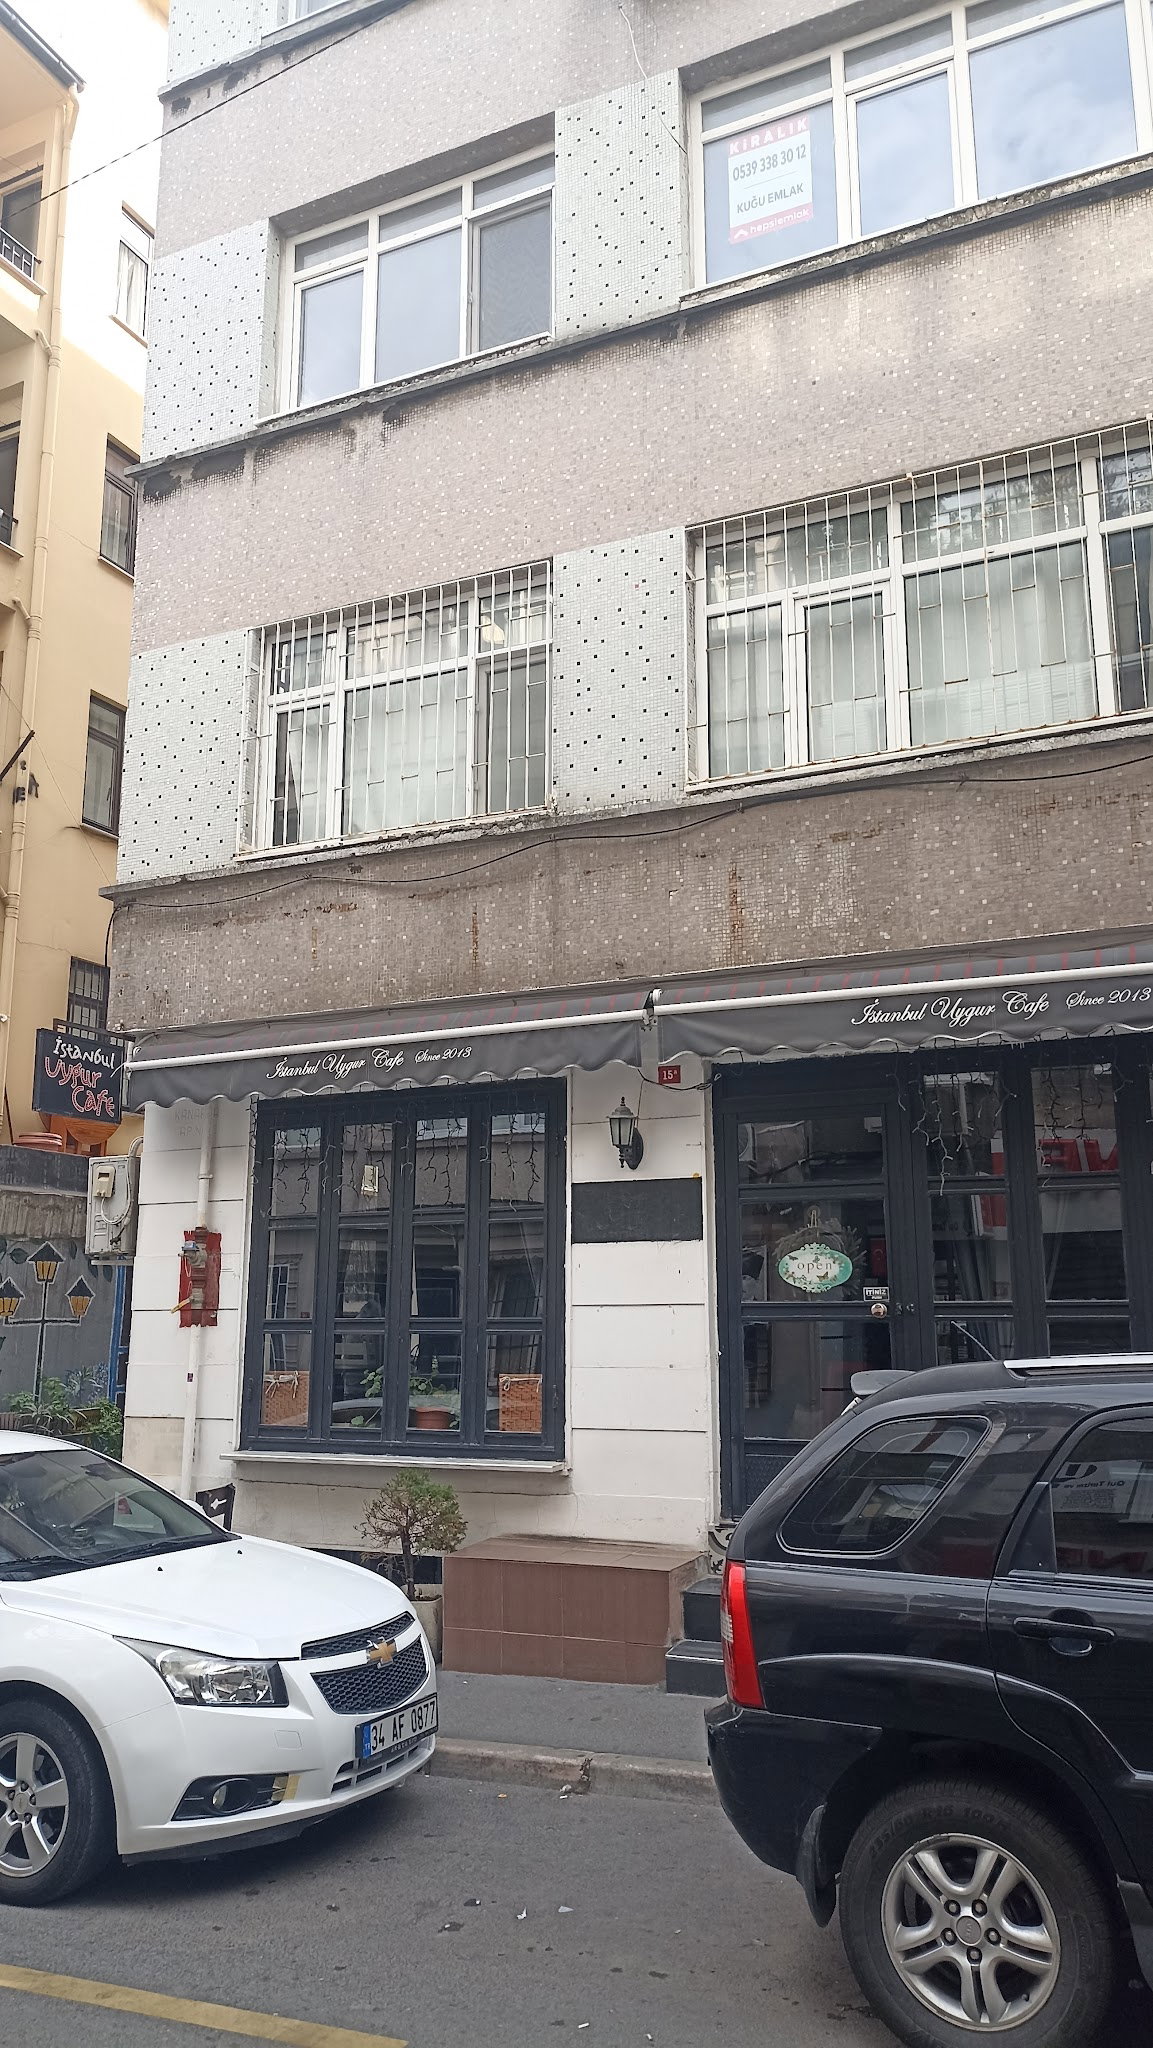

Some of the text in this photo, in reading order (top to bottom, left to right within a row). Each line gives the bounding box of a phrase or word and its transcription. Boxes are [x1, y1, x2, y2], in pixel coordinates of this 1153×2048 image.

[732, 144, 807, 181] 0539 338 30 12
[737, 182, 804, 214] KUĞU EMLAK
[750, 208, 810, 234] hepsiemlak
[851, 987, 1151, 1028] İstanbul Uygur Cafe Since 2013
[44, 1056, 102, 1088] Uygur
[266, 1046, 472, 1080] İstanbul Uygur Cafe Since 2013
[71, 1085, 115, 1117] Cafe
[797, 1261, 832, 1274] open
[371, 1723, 385, 1751] 34
[392, 1713, 405, 1742] AF
[411, 1700, 436, 1733] 0877
